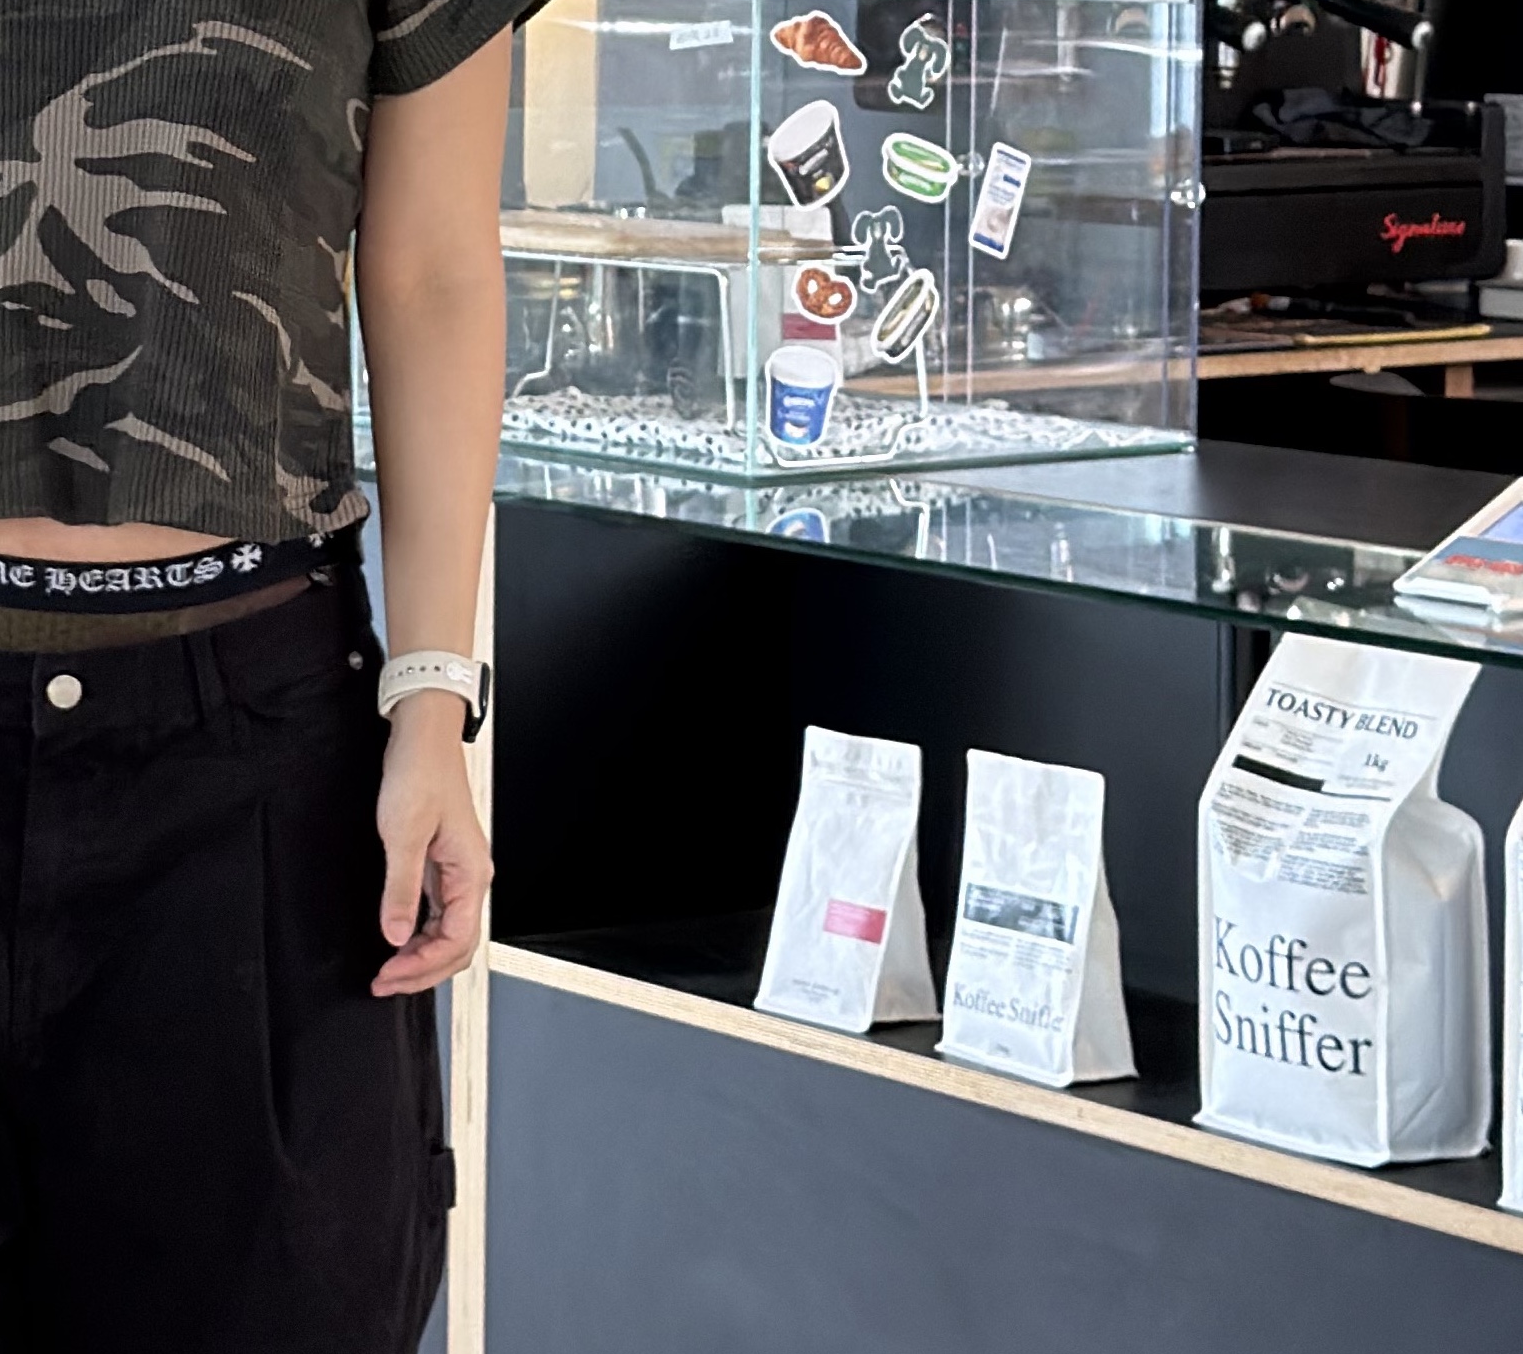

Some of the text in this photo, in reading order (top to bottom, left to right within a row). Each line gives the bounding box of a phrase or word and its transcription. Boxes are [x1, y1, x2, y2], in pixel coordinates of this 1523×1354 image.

[44, 556, 224, 596] HEARTS
[1266, 688, 1355, 729] TOASTY
[1354, 713, 1419, 740] BLEND
[1215, 915, 1372, 1000] Koffee
[953, 982, 1006, 1018] Koffee
[1215, 990, 1373, 1076] Sniffer
